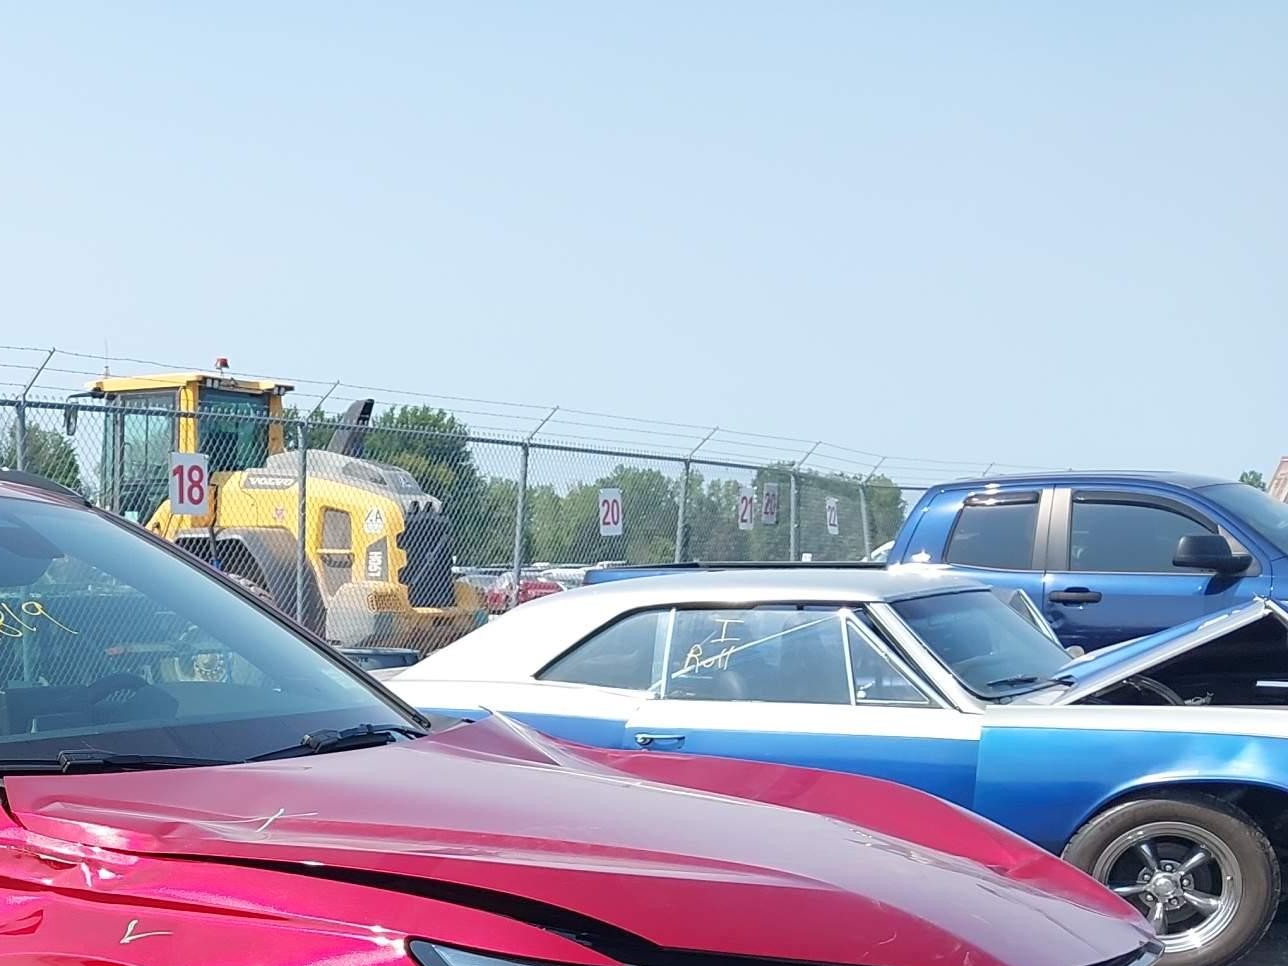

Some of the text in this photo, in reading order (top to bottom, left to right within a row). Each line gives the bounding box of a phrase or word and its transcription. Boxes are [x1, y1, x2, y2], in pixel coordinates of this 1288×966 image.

[172, 464, 205, 506] 18
[249, 477, 294, 486] VOLVO
[601, 498, 621, 526] 20
[740, 495, 753, 524] 21
